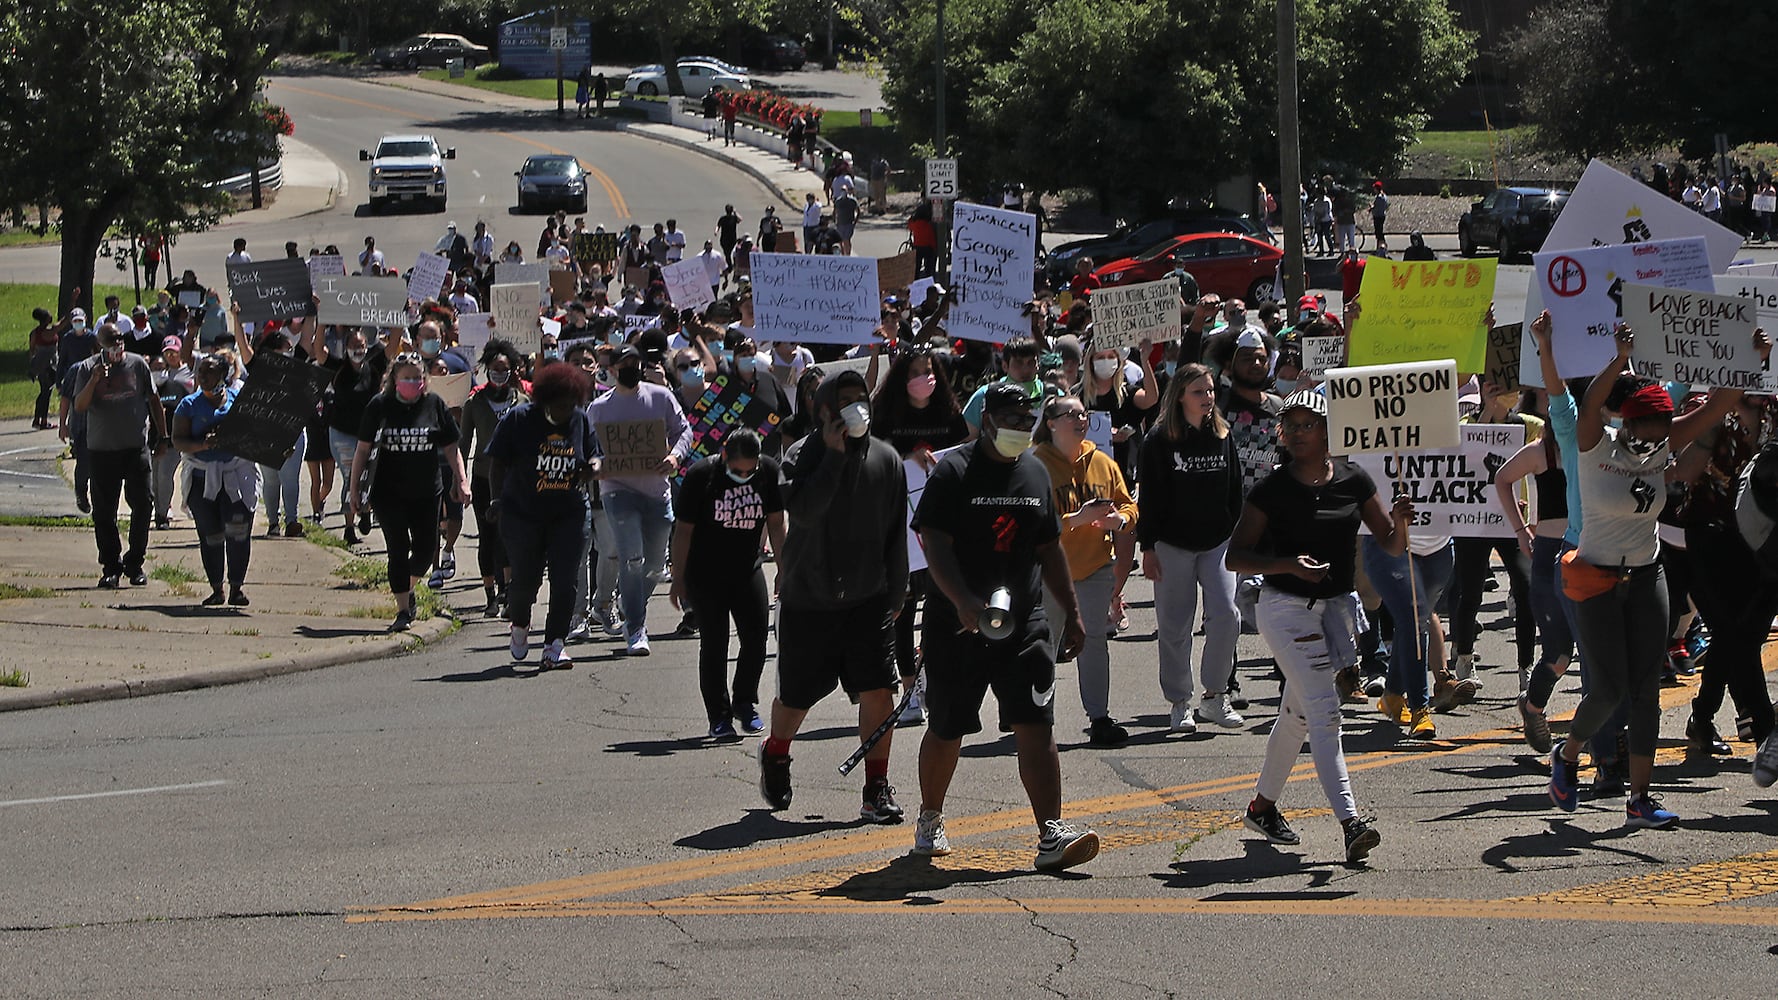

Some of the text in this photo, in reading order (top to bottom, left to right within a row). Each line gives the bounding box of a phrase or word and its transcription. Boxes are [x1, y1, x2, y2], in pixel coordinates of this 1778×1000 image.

[930, 180, 954, 194] 25
[955, 225, 1019, 263] George
[231, 270, 261, 286] Black
[321, 278, 337, 293] I
[256, 286, 287, 299] Lives
[496, 288, 519, 304] NO
[681, 281, 699, 298] IS
[271, 300, 307, 316] Matter
[1649, 291, 1750, 323] LOVE BLACK
[1661, 312, 1720, 336] PEOPLE
[1665, 334, 1734, 361] LIKE YOU
[1674, 361, 1718, 386] BLACK
[694, 375, 729, 412] TIRED
[1330, 377, 1362, 399] NO
[709, 392, 752, 441] RACISM
[1374, 396, 1406, 420] NO
[384, 427, 429, 436] BLACK
[387, 436, 428, 444] LIVES
[606, 423, 656, 440] BLACK
[1344, 425, 1420, 449] DEATH
[538, 443, 576, 456] Proud
[608, 439, 657, 455] LIVES
[536, 455, 576, 472] MOM
[1384, 455, 1476, 479] UNTIL
[548, 471, 564, 479] OF A
[723, 484, 754, 500] ANTI
[1391, 480, 1488, 504] BLACK
[714, 492, 763, 511] DRAMA
[714, 504, 764, 522] DRAMA
[723, 519, 756, 530] CLUB
